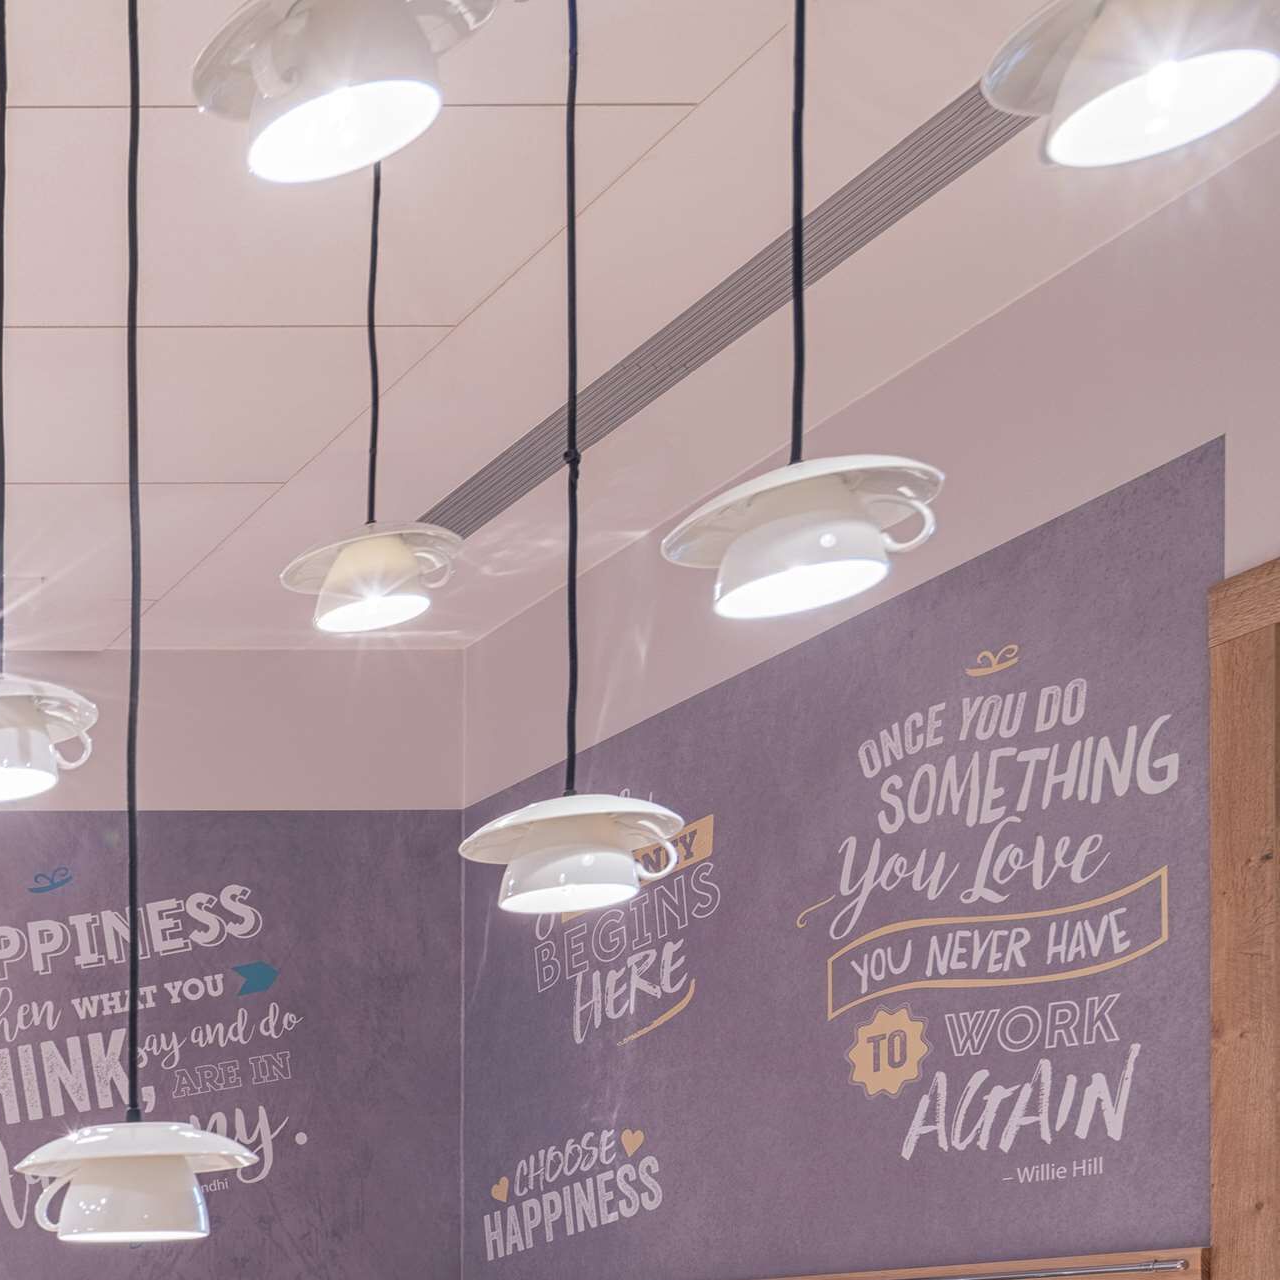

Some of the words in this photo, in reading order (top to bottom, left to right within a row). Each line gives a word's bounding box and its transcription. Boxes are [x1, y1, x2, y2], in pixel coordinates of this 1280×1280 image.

[858, 702, 945, 778] ONCE
[958, 690, 1028, 742] YOU
[1034, 677, 1087, 727] DO
[877, 714, 1179, 834] SOMETHING
[960, 816, 1110, 904] Love
[534, 862, 722, 993] BEGINS
[850, 939, 912, 995] YOU
[925, 925, 1032, 978] NEVER
[1046, 907, 1132, 966] HAVE
[71, 985, 157, 1021] WHAT
[165, 973, 225, 1005] YOU
[573, 937, 689, 1044] HERE
[944, 992, 1122, 1058] WORK
[136, 1031, 188, 1070] say
[191, 1007, 255, 1048] and
[259, 1002, 304, 1038] do
[172, 1060, 242, 1099] ARE
[249, 1051, 292, 1085] IN
[866, 1028, 908, 1074] TO
[900, 1042, 1143, 1161] AGAIN
[513, 1128, 617, 1197] CHOOSE
[1072, 1156, 1104, 1177] Hill
[483, 1154, 663, 1262] HAPPINESS
